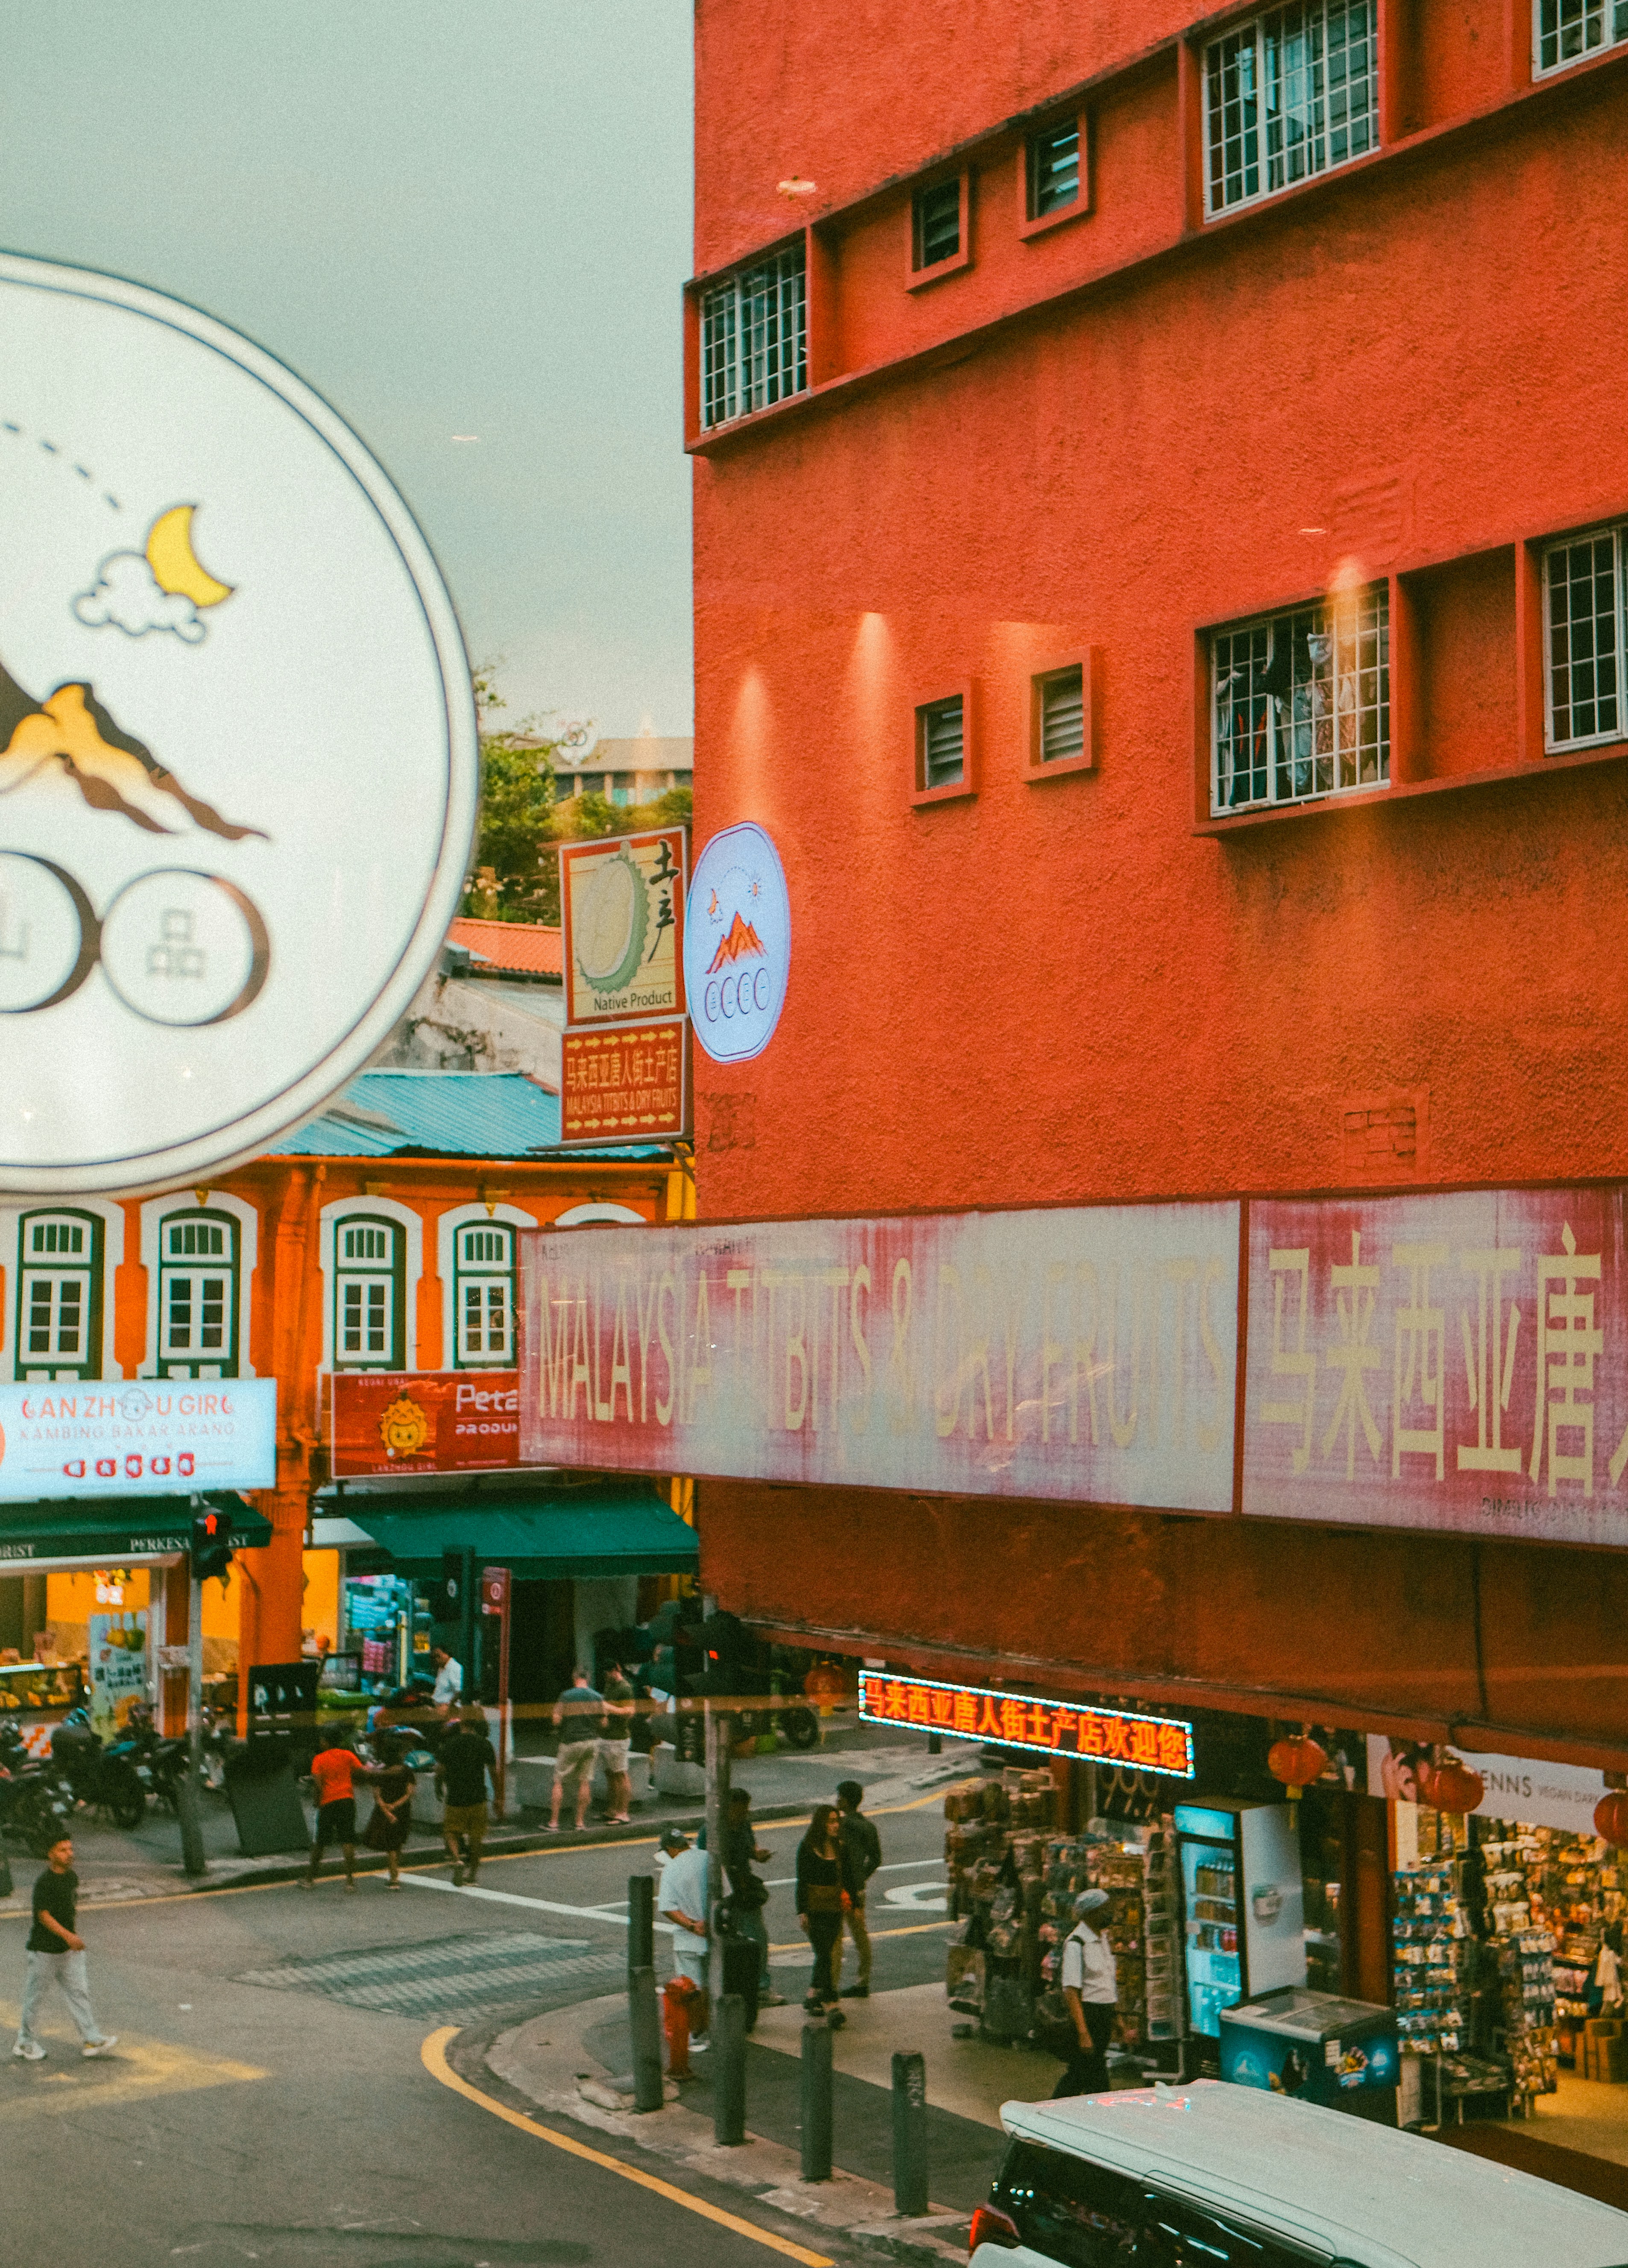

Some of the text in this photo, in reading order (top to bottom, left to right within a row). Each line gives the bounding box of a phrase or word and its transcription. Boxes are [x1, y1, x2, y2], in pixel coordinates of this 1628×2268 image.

[594, 991, 673, 1012] Native Product
[1259, 1220, 1628, 1498] 马来西亚唐
[20, 1426, 105, 1441] KAMBING
[112, 1422, 169, 1439] BAKAR
[864, 1678, 1187, 1769] 马来西亚唐人街土产店欢迎您
